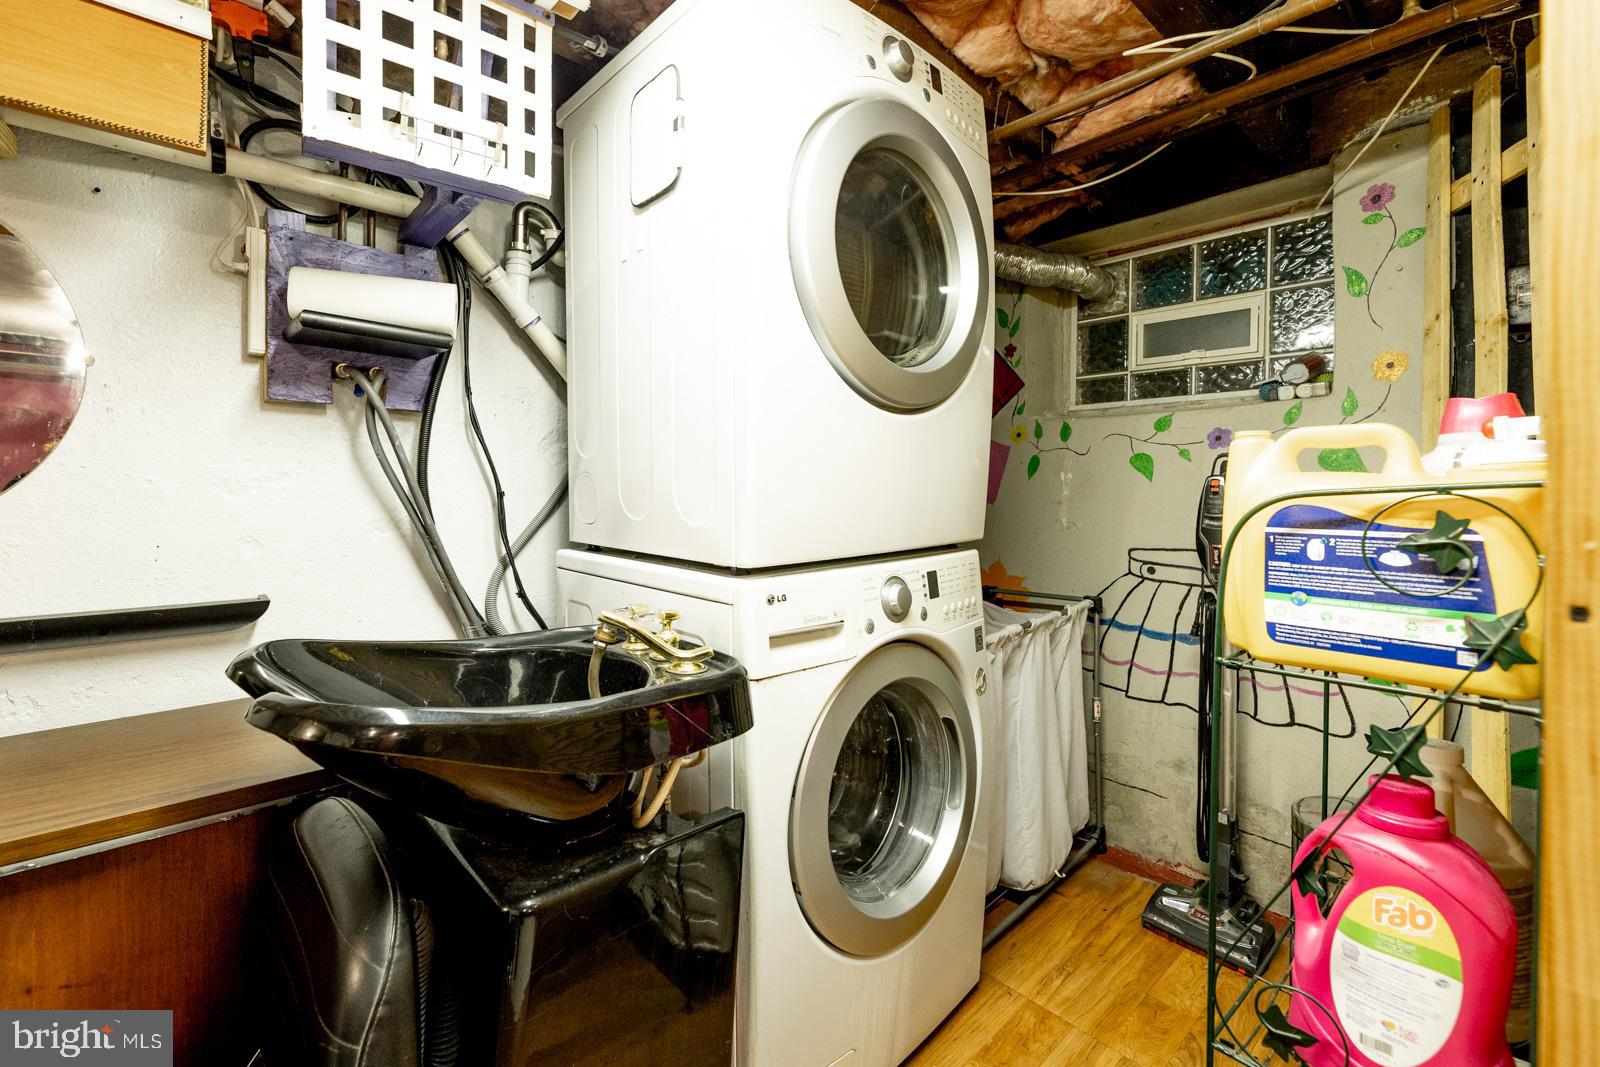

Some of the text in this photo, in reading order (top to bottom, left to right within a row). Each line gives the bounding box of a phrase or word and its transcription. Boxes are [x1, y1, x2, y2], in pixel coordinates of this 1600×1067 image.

[1329, 538, 1336, 546] 2
[776, 594, 787, 602] LG
[1374, 898, 1433, 931] Fab
